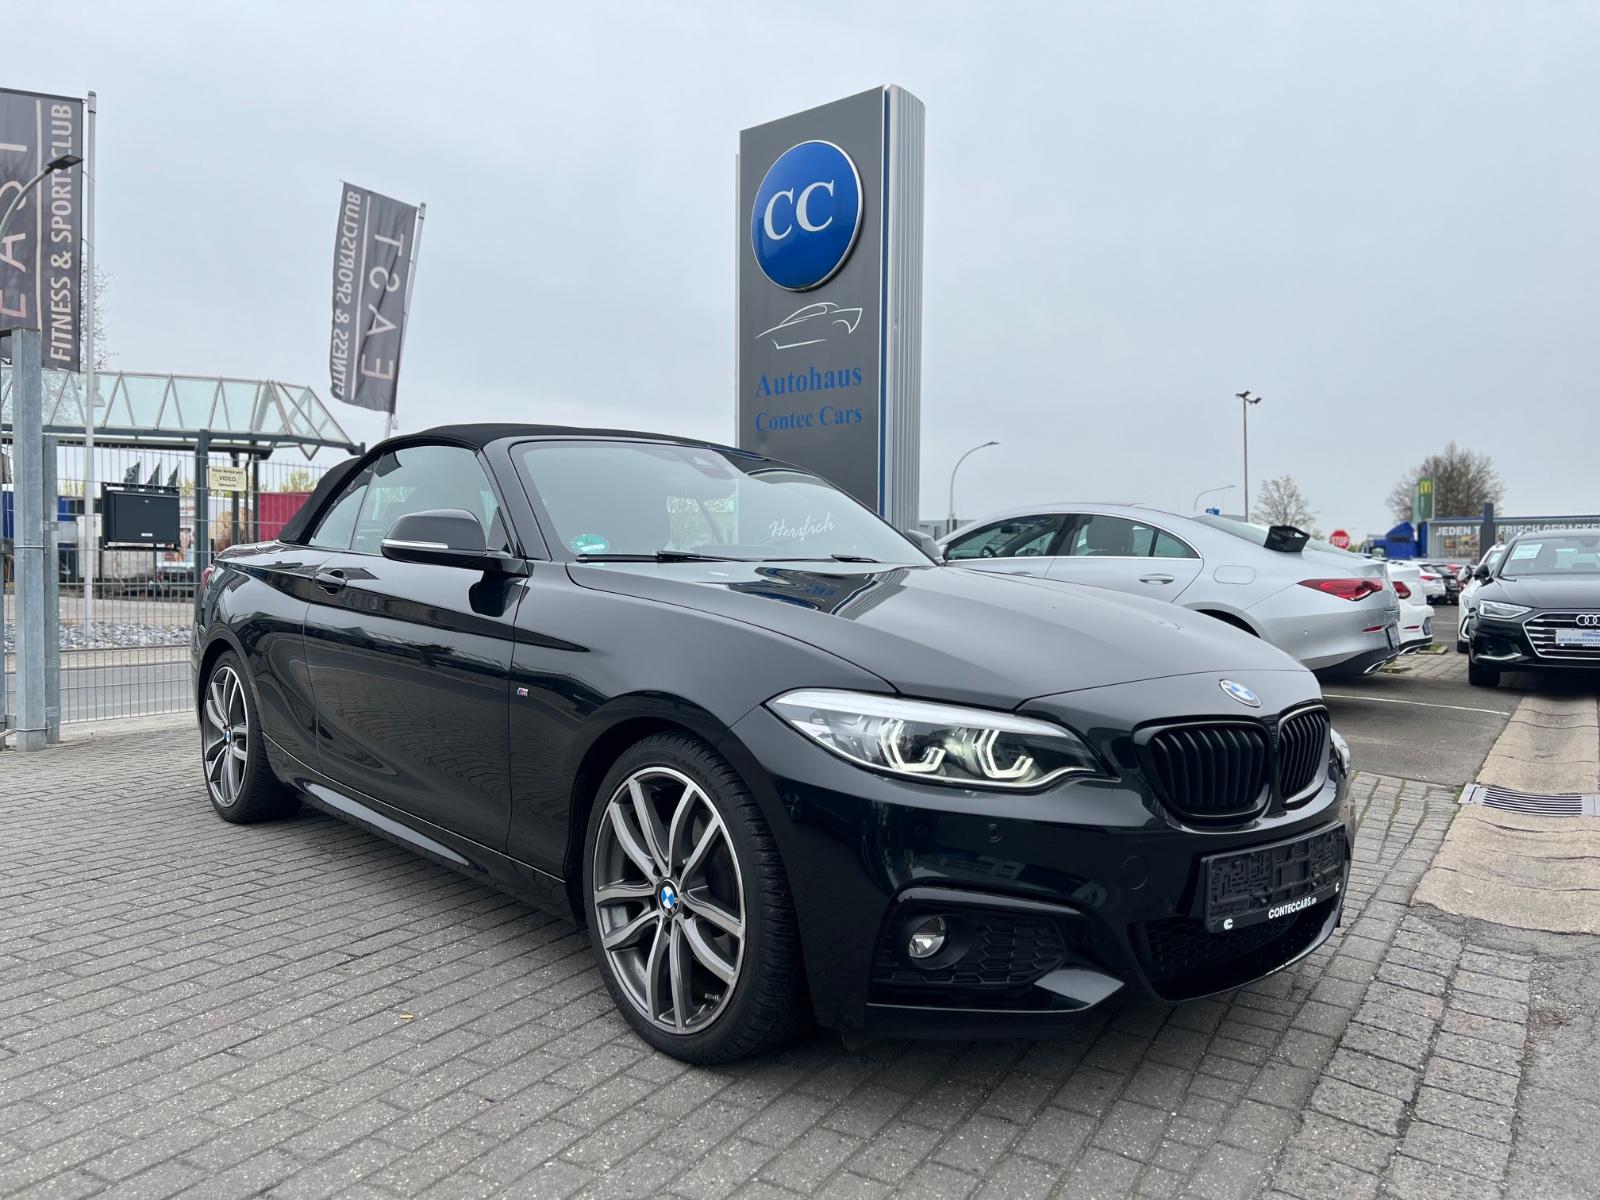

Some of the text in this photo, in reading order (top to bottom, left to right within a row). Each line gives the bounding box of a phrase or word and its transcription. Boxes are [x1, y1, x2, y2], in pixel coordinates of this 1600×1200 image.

[763, 180, 834, 240] CC
[50, 250, 72, 270] &
[50, 276, 72, 361] FITNESS
[755, 366, 863, 397] Autohaus
[755, 405, 863, 432] Contec Cars
[768, 511, 834, 541] Herzlich
[1436, 526, 1472, 536] JEDEN
[1498, 525, 1541, 534] FRISCH
[1331, 536, 1349, 546] STOP
